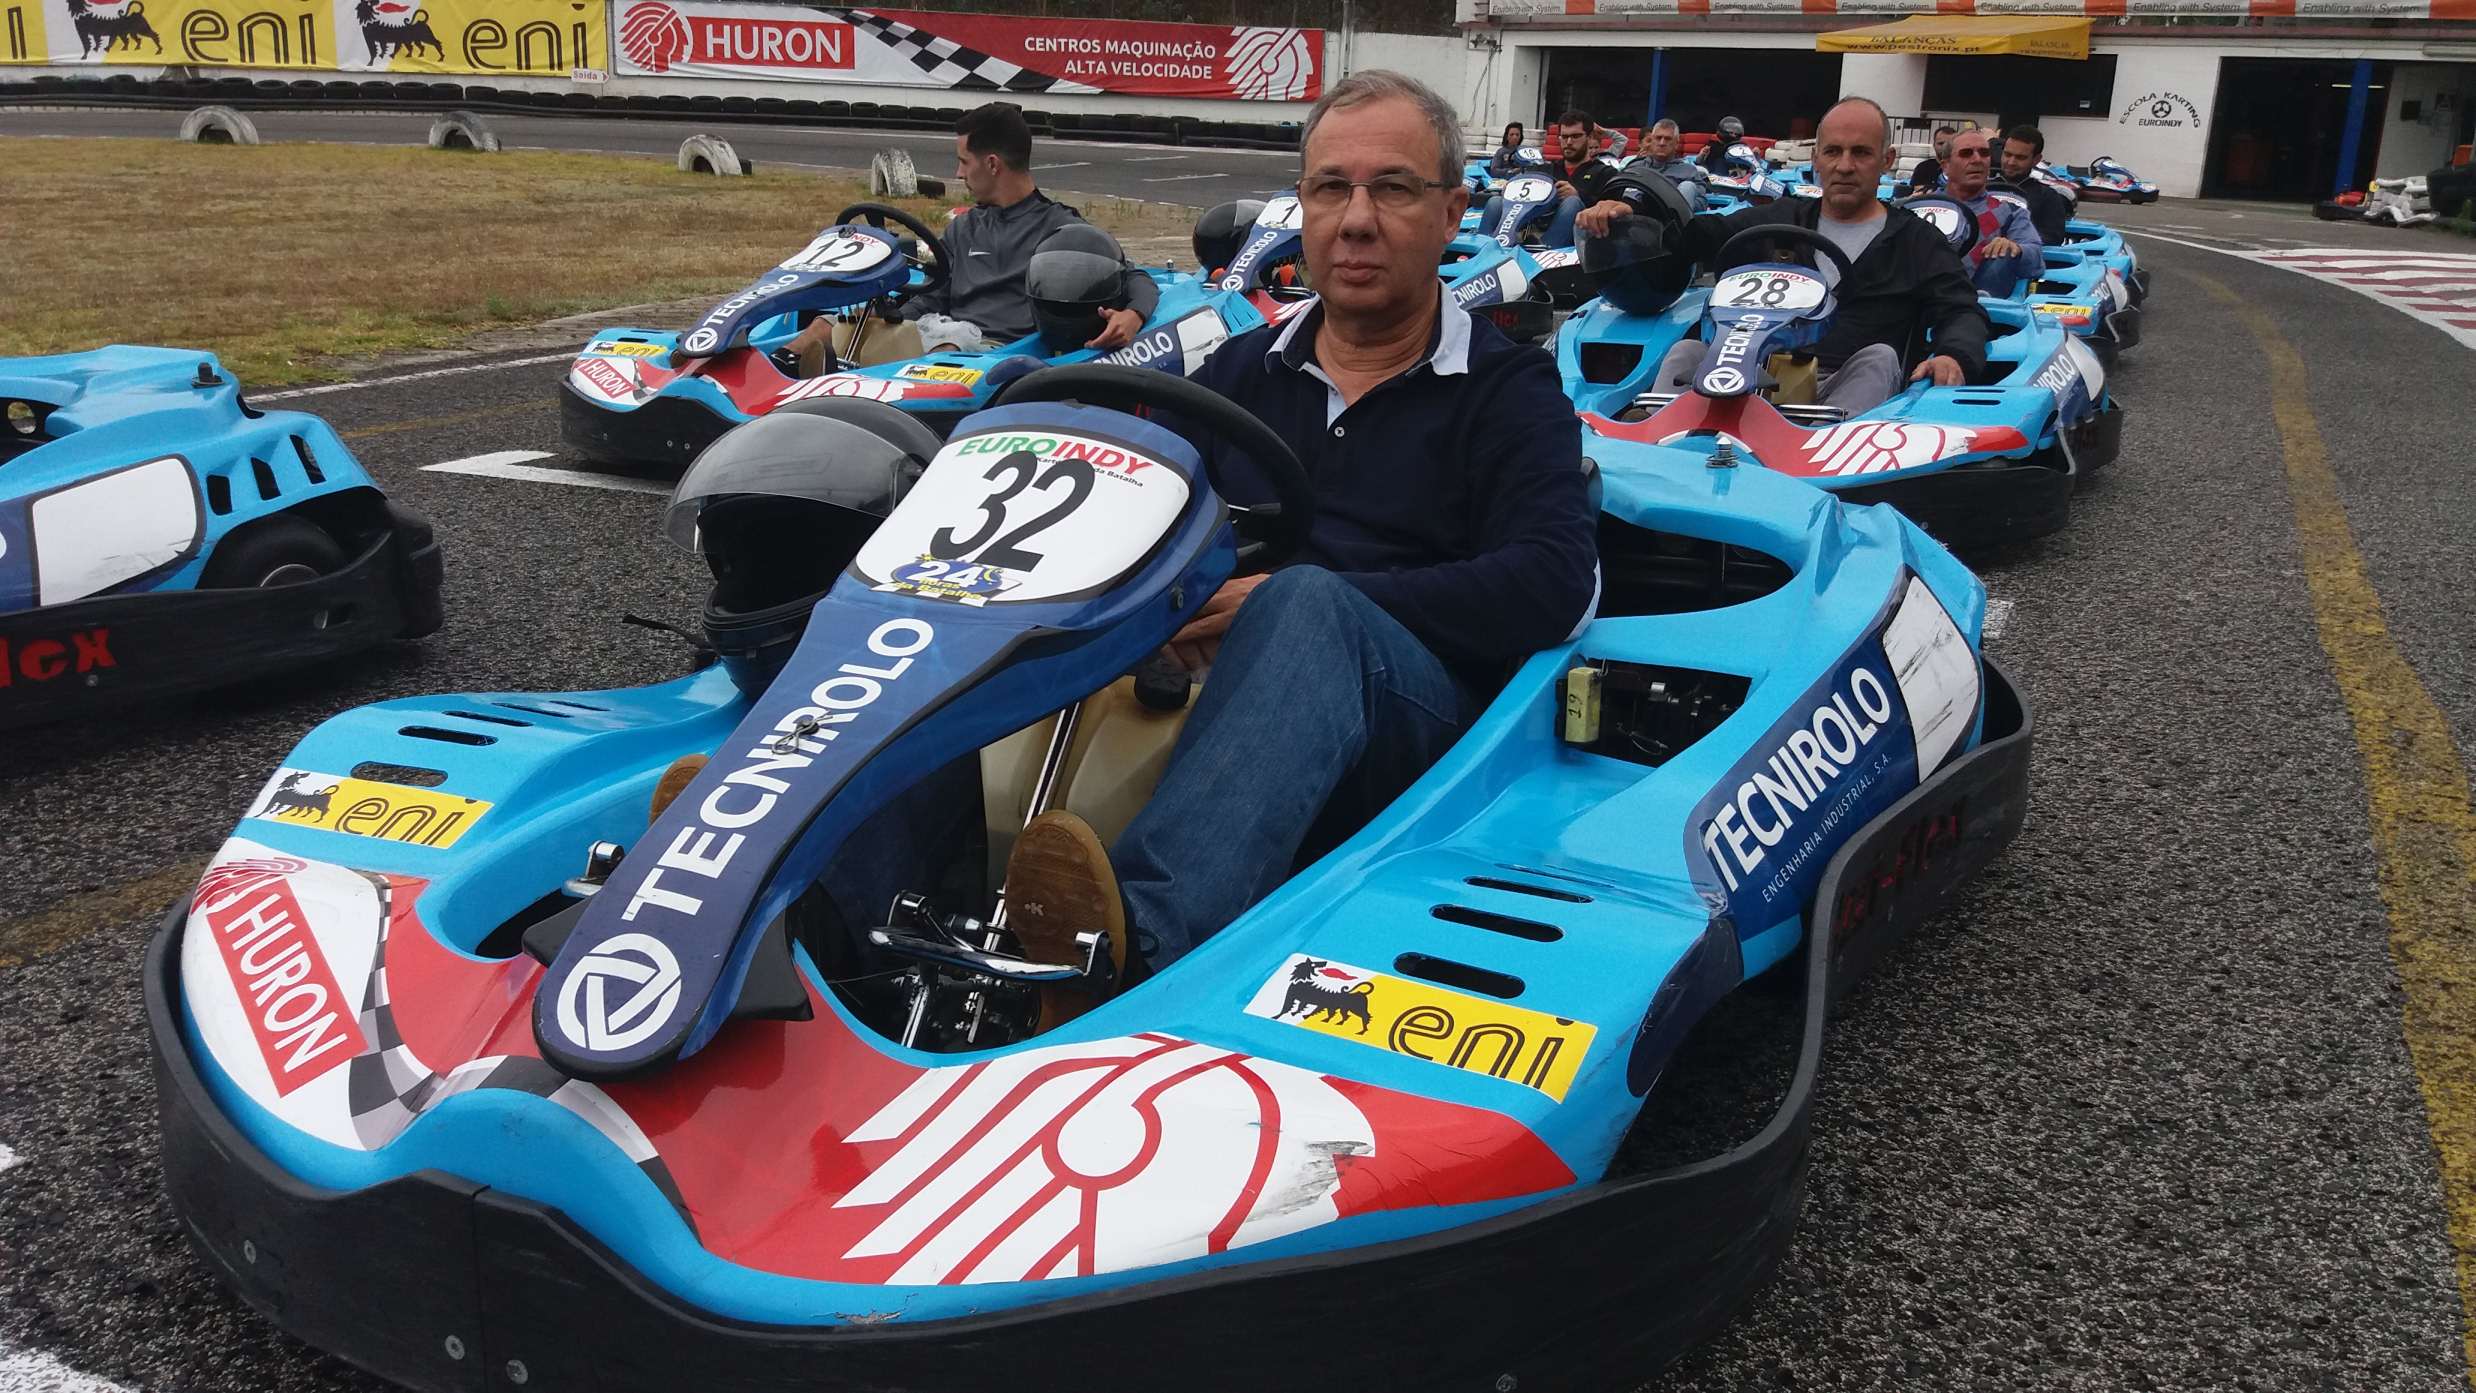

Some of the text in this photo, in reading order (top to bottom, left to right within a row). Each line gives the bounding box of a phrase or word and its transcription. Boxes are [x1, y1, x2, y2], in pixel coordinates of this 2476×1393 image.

[181, 8, 318, 66] eni
[462, 3, 588, 71] eni
[706, 24, 841, 63] HURON
[1024, 37, 1216, 61] CENTROS MAQUINAÇÃO
[1065, 60, 1212, 79] ALTA VELOCIDADE
[2119, 91, 2201, 129] ESCOLA KARTING
[2138, 118, 2183, 128] EUROINDY
[1519, 181, 1533, 198] 5
[803, 238, 865, 268] 12
[1452, 273, 1497, 306] CNIROLO
[1728, 277, 1790, 306] 28
[584, 360, 631, 396] HURON
[956, 436, 1153, 476] EUROINDY
[929, 450, 1096, 573] 32
[905, 560, 985, 588] 24
[621, 618, 934, 922] TECNIROLO
[1702, 667, 1891, 893] TECNIROLO
[334, 796, 478, 846] eni
[1761, 831, 1823, 903] ENGENHARIA
[225, 892, 349, 1075] HURON
[1387, 1005, 1575, 1090] eni
